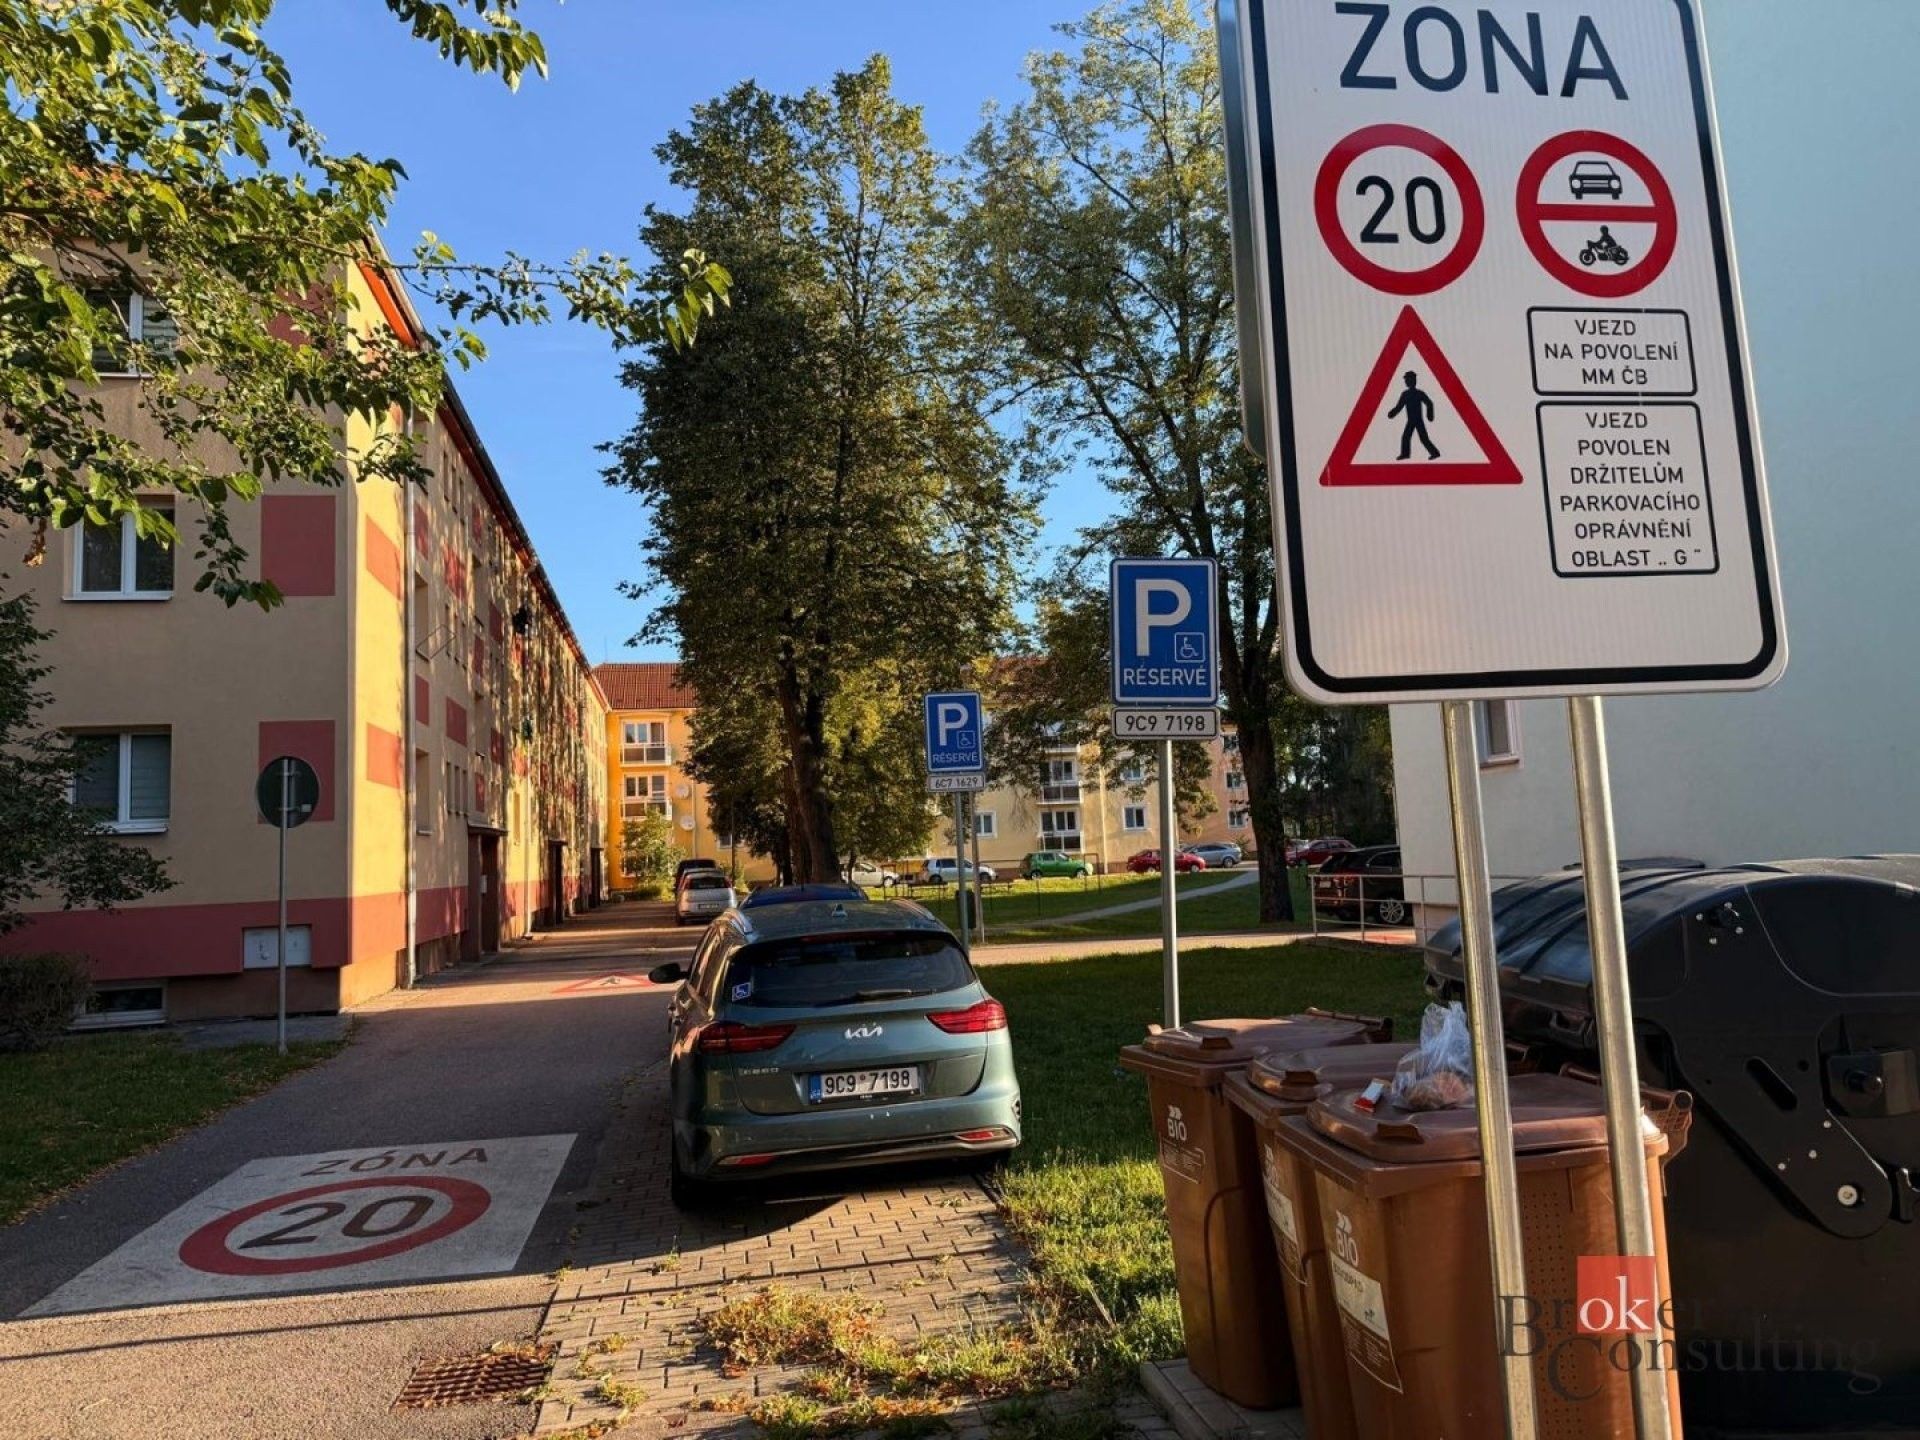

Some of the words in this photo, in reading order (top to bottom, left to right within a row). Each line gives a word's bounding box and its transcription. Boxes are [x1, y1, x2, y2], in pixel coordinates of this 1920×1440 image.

[1335, 2, 1629, 100] ZONA
[1355, 175, 1446, 245] 20
[1575, 319, 1636, 337] VJEZD
[1544, 343, 1573, 360] NA
[1581, 341, 1679, 361] POVOLENÍ
[1582, 368, 1615, 385] MM
[1622, 366, 1648, 385] ČB
[1585, 412, 1648, 429] VJEZD
[1578, 439, 1670, 456] POVOLEN
[1571, 462, 1684, 484] DRŽITELŮM
[1560, 492, 1700, 512] PARKOVACÍHO
[1574, 520, 1692, 540] OPRÁVNĚNÍ
[1571, 550, 1651, 567] OBLAST
[1135, 579, 1192, 657] P
[937, 702, 969, 746] P
[1125, 715, 1158, 732] 9C9
[1164, 715, 1206, 732] 7198
[825, 1076, 857, 1094] 9C9
[868, 1070, 910, 1091] 7198
[1167, 1118, 1188, 1142] BIO
[301, 1147, 488, 1177] ZÓNA
[237, 1195, 436, 1249] 20
[1336, 1228, 1359, 1268] BIO
